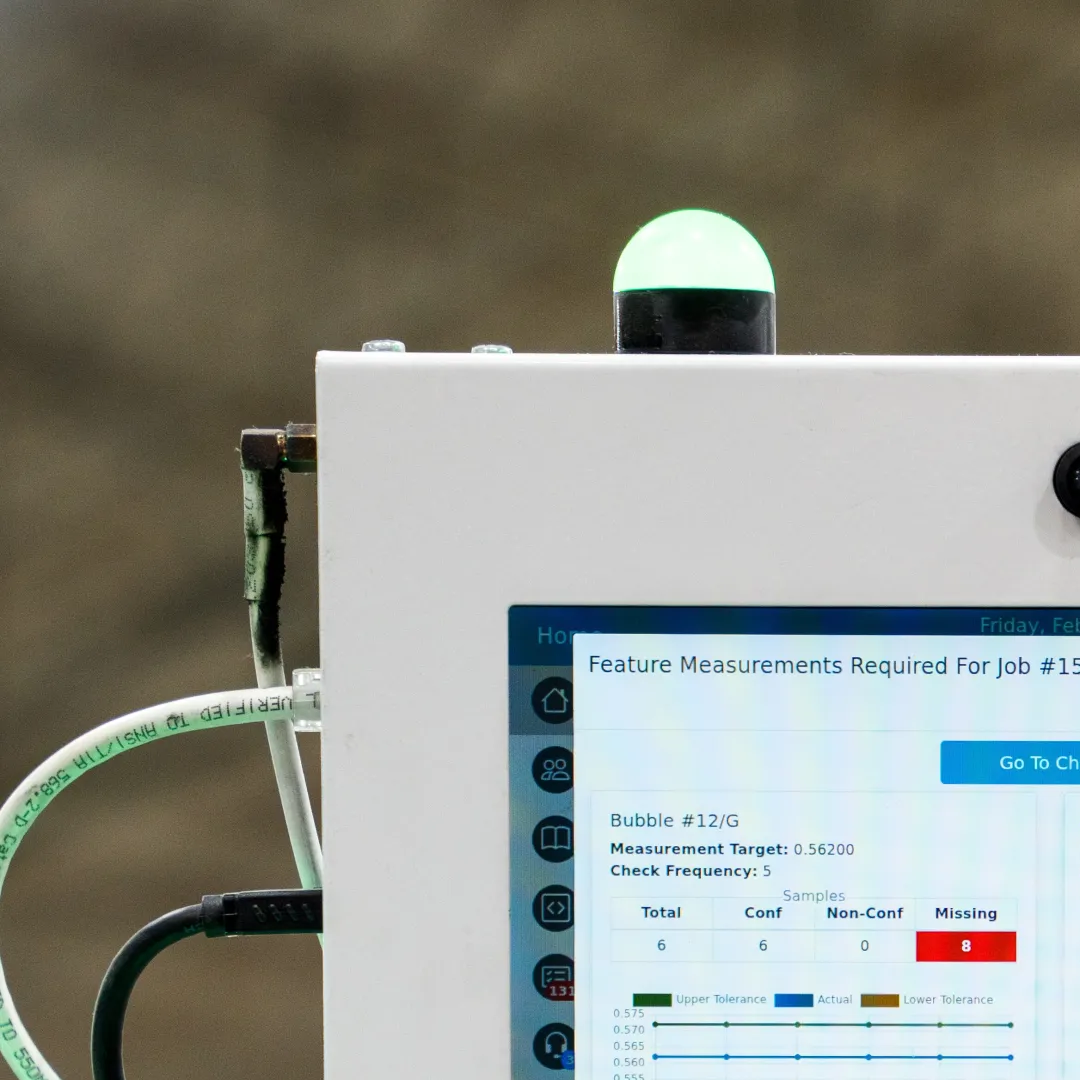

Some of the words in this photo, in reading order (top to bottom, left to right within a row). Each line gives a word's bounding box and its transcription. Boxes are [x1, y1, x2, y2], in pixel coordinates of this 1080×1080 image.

[980, 617, 1045, 636] Friday,
[538, 627, 602, 645] Ho
[589, 655, 672, 674] Feature
[680, 655, 843, 675] Measurements
[851, 656, 948, 679] Required
[957, 657, 991, 675] For
[995, 656, 1031, 680] Job
[200, 695, 293, 722] VERIFIED
[166, 712, 191, 731] TO
[72, 721, 158, 770] ANSI/TIA
[999, 755, 1025, 770] Go
[1029, 755, 1050, 770] To
[610, 812, 674, 828] Bubble
[681, 813, 739, 830] #12/G
[610, 842, 725, 855] Measurement
[729, 843, 788, 858] Target:
[793, 843, 855, 856] 0.56200
[610, 864, 660, 877] Check
[665, 864, 757, 880] Frequency:
[763, 864, 772, 877] 5
[783, 889, 846, 904] Samples
[640, 906, 681, 919] Total
[744, 906, 783, 919] Conf
[827, 906, 904, 919] Non-Conf
[935, 907, 997, 922] Missing
[657, 938, 667, 952] 6
[758, 939, 768, 952] 6
[860, 939, 870, 952] 0
[961, 939, 972, 953] 8
[676, 994, 711, 1007] Upper
[713, 993, 767, 1005] Tolerance
[817, 994, 853, 1004] Actual
[903, 995, 937, 1005] Lower
[940, 994, 994, 1005] Tolerance
[613, 1008, 645, 1019] 0.575
[613, 1024, 645, 1035] 0.570
[613, 1041, 645, 1051] 0.565
[613, 1057, 645, 1067] 0.560
